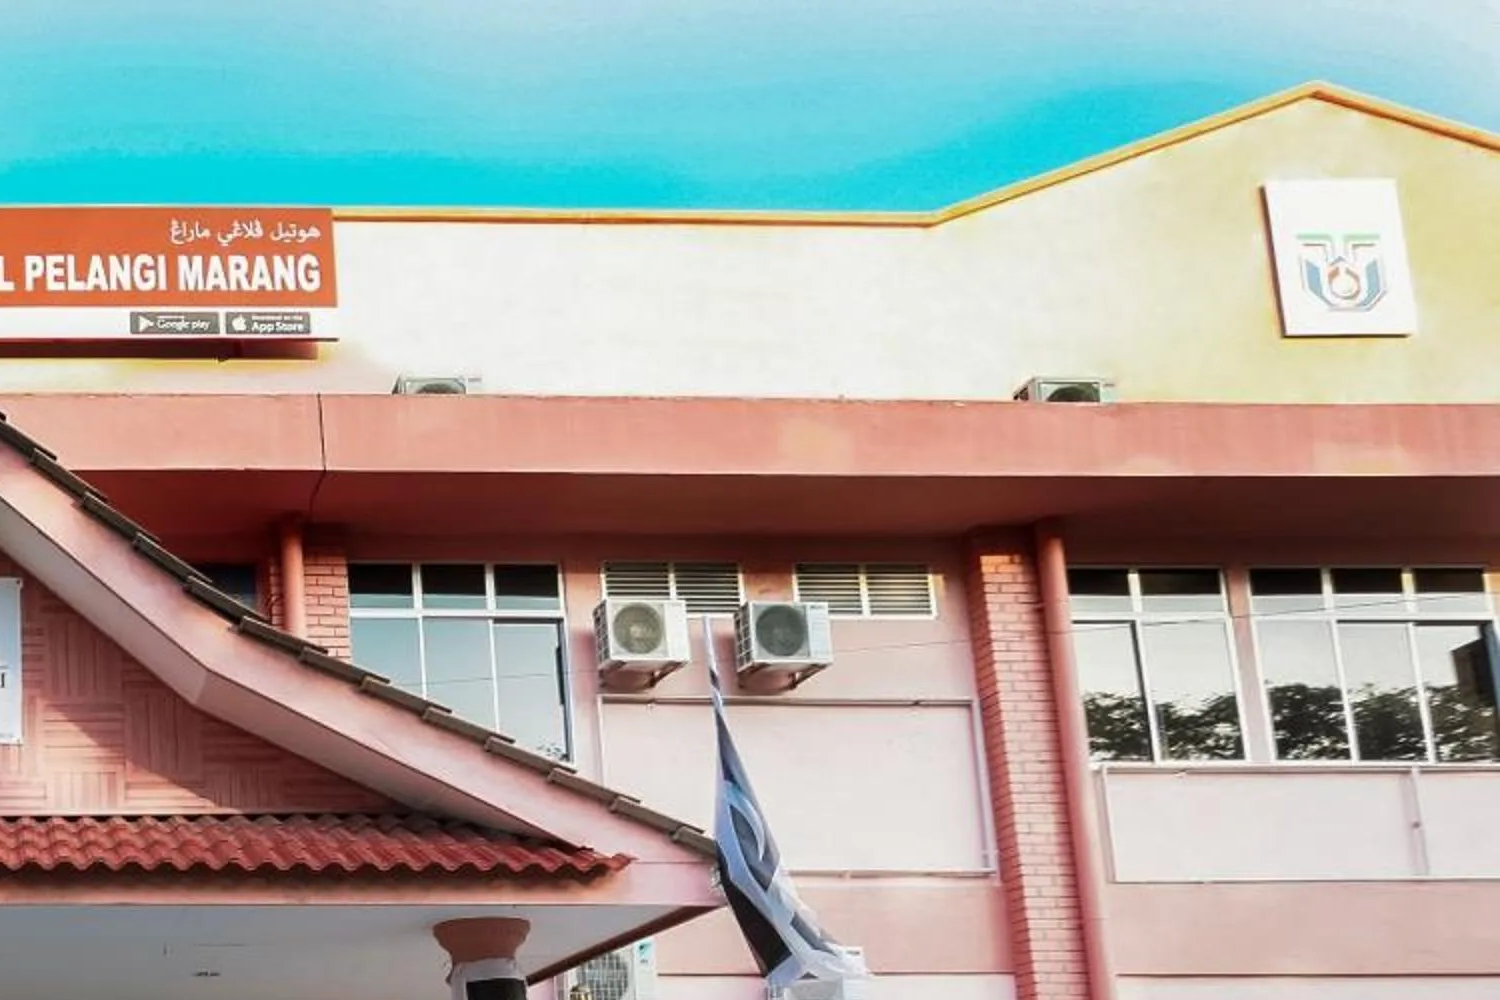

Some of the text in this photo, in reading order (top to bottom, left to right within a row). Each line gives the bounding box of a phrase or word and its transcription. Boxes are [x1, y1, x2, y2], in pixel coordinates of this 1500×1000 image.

[25, 254, 167, 292] PELANGI
[178, 253, 321, 291] MARANG
[157, 319, 190, 331] Google
[251, 320, 304, 333] App Store
